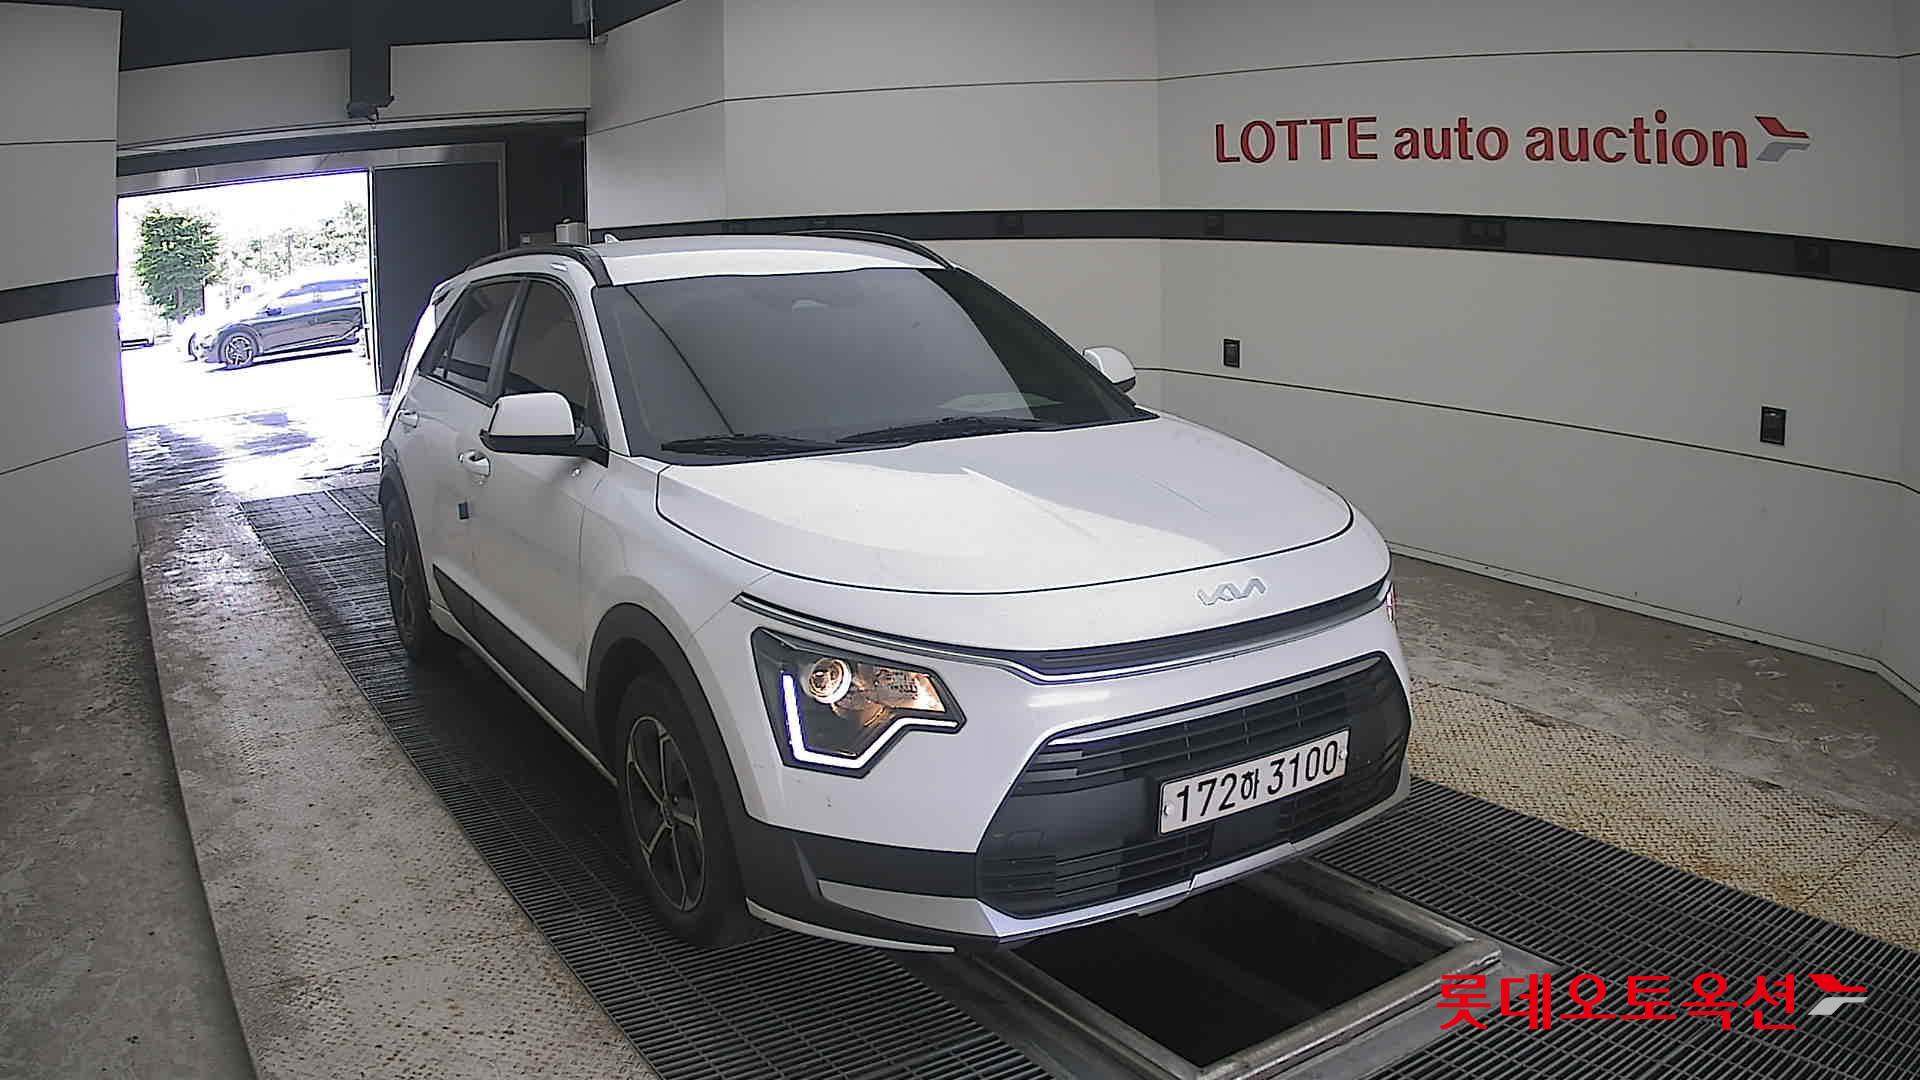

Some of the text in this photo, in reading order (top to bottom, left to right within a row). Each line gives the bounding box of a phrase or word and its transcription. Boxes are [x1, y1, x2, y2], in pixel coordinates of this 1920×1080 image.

[1216, 110, 1748, 168] LOTTE auto auction
[1176, 740, 1339, 822] 172하 3100
